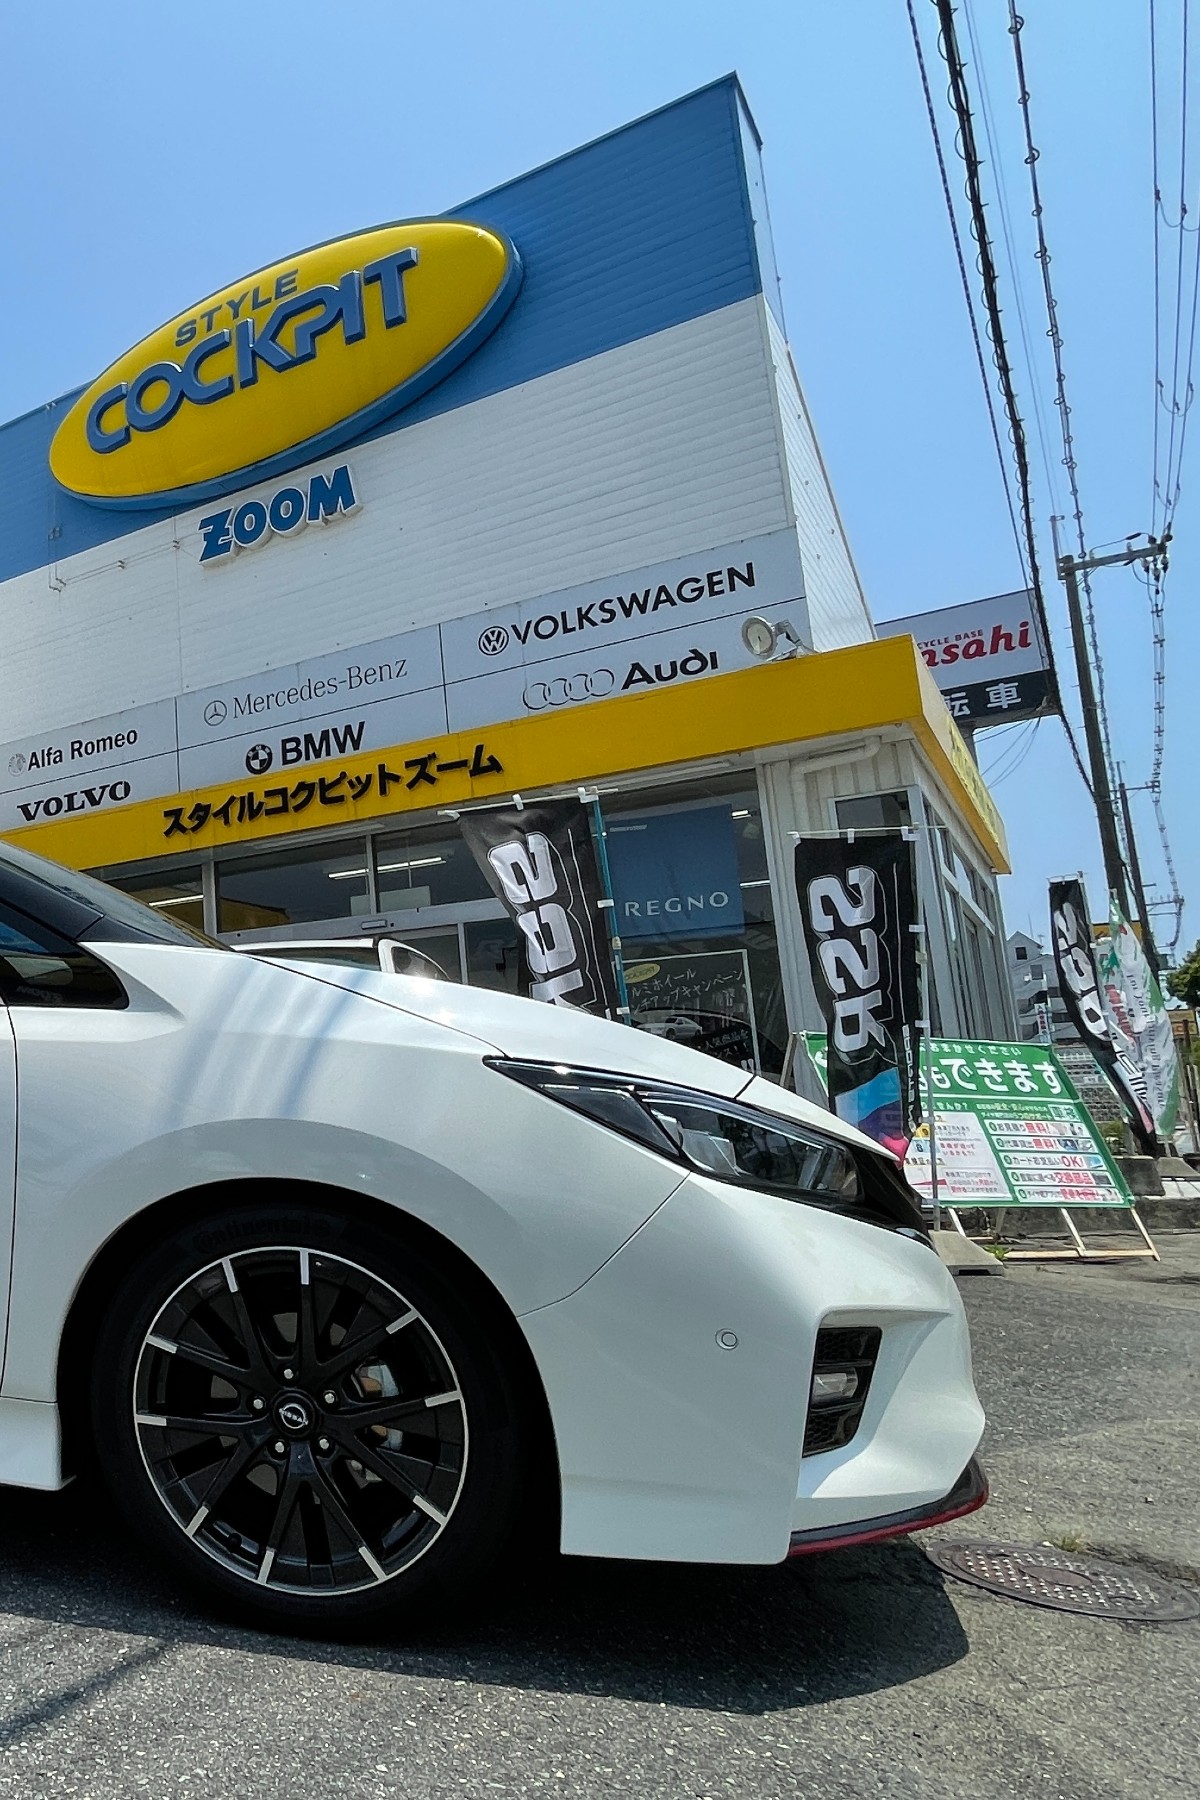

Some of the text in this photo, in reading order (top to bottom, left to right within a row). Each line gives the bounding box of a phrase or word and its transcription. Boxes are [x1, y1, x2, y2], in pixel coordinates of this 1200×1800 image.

[175, 269, 299, 347] STYLE
[86, 247, 418, 455] COCKPIT
[198, 464, 358, 565] ZOOM
[511, 561, 755, 645] VOLKSWAGEN
[955, 629, 983, 641] BASE
[233, 658, 407, 719] Mercedes-Benz
[621, 649, 719, 690] Audi
[28, 746, 63, 771] Alfa
[70, 729, 138, 760] Romeo
[281, 721, 365, 765] BMW
[17, 781, 131, 821] VOLVO
[163, 744, 503, 838] スタイルコクピットズーム
[625, 891, 728, 917] REGNO
